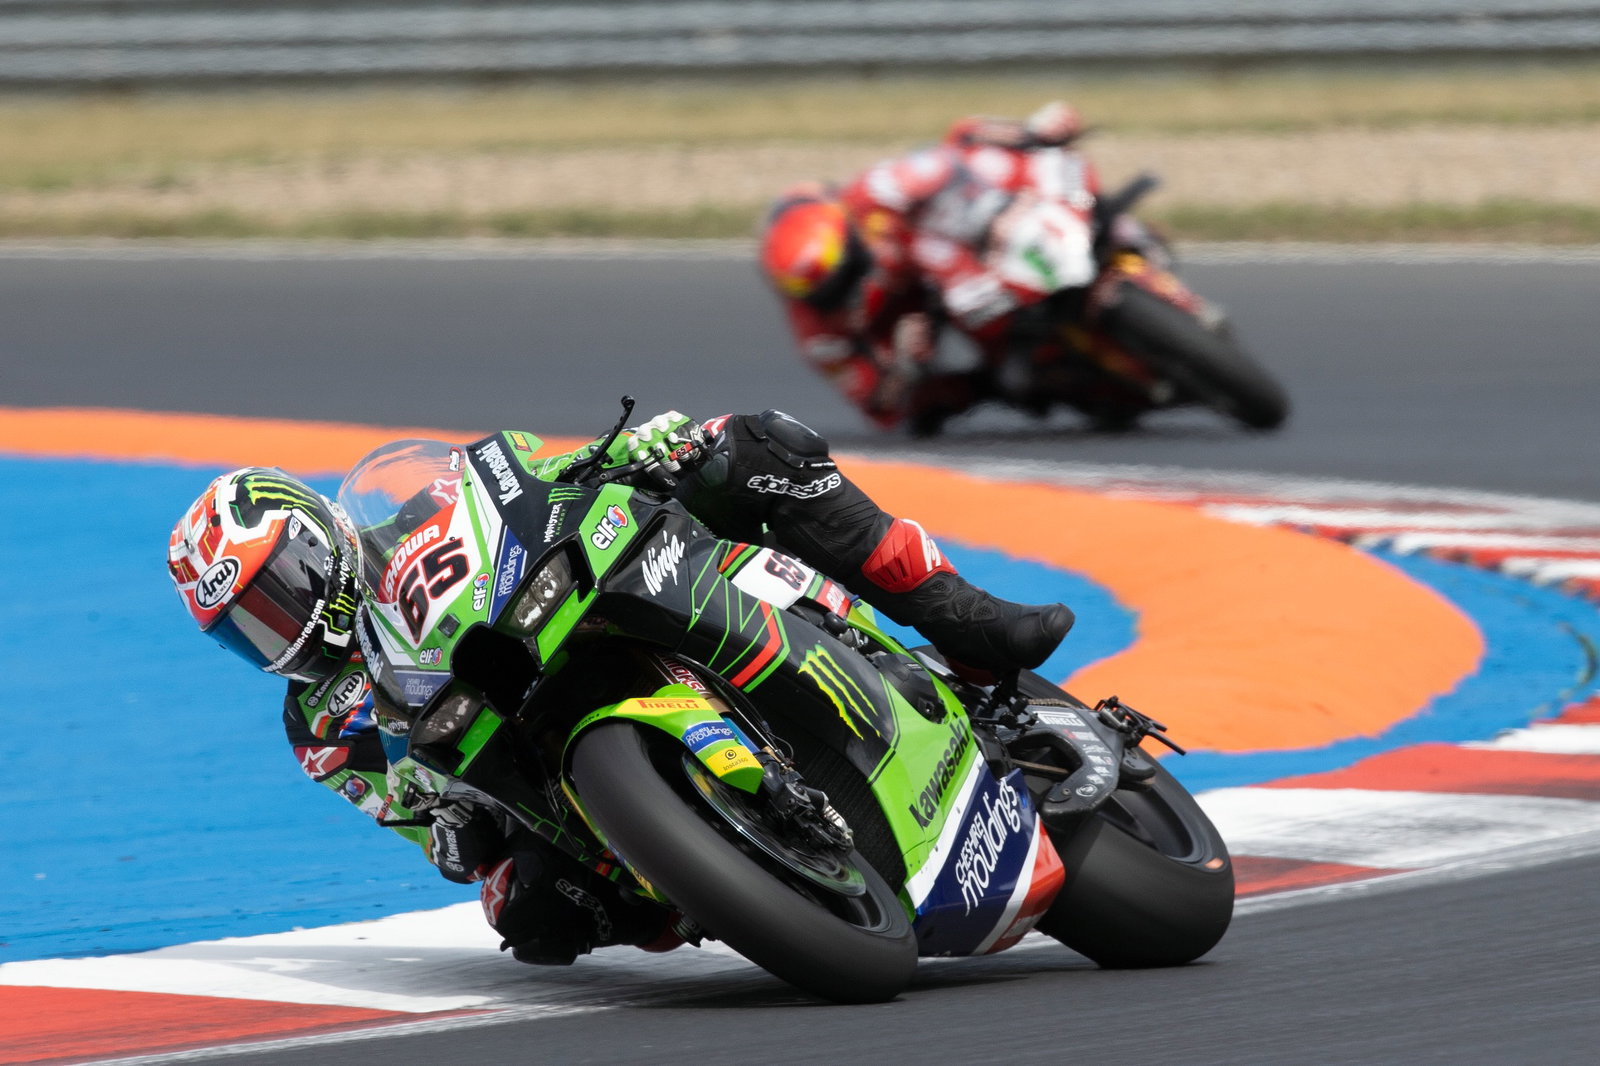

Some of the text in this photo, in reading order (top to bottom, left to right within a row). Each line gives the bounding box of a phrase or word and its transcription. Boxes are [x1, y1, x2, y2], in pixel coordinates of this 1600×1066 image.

[475, 440, 524, 506] Kawasaki
[746, 472, 842, 500] alpinestars
[591, 516, 618, 551] elf
[202, 560, 233, 606] Arai
[385, 524, 441, 602] SHOWA
[641, 529, 686, 597] Ninja
[764, 550, 808, 592] 65
[399, 536, 471, 645] 65
[471, 586, 486, 611] elf
[419, 648, 434, 665] elf
[333, 673, 361, 714] Arai
[636, 699, 701, 709] PIRELLI
[908, 711, 971, 829] Kawasaki
[445, 827, 461, 864] Kawas
[960, 776, 1022, 918] mouldings
